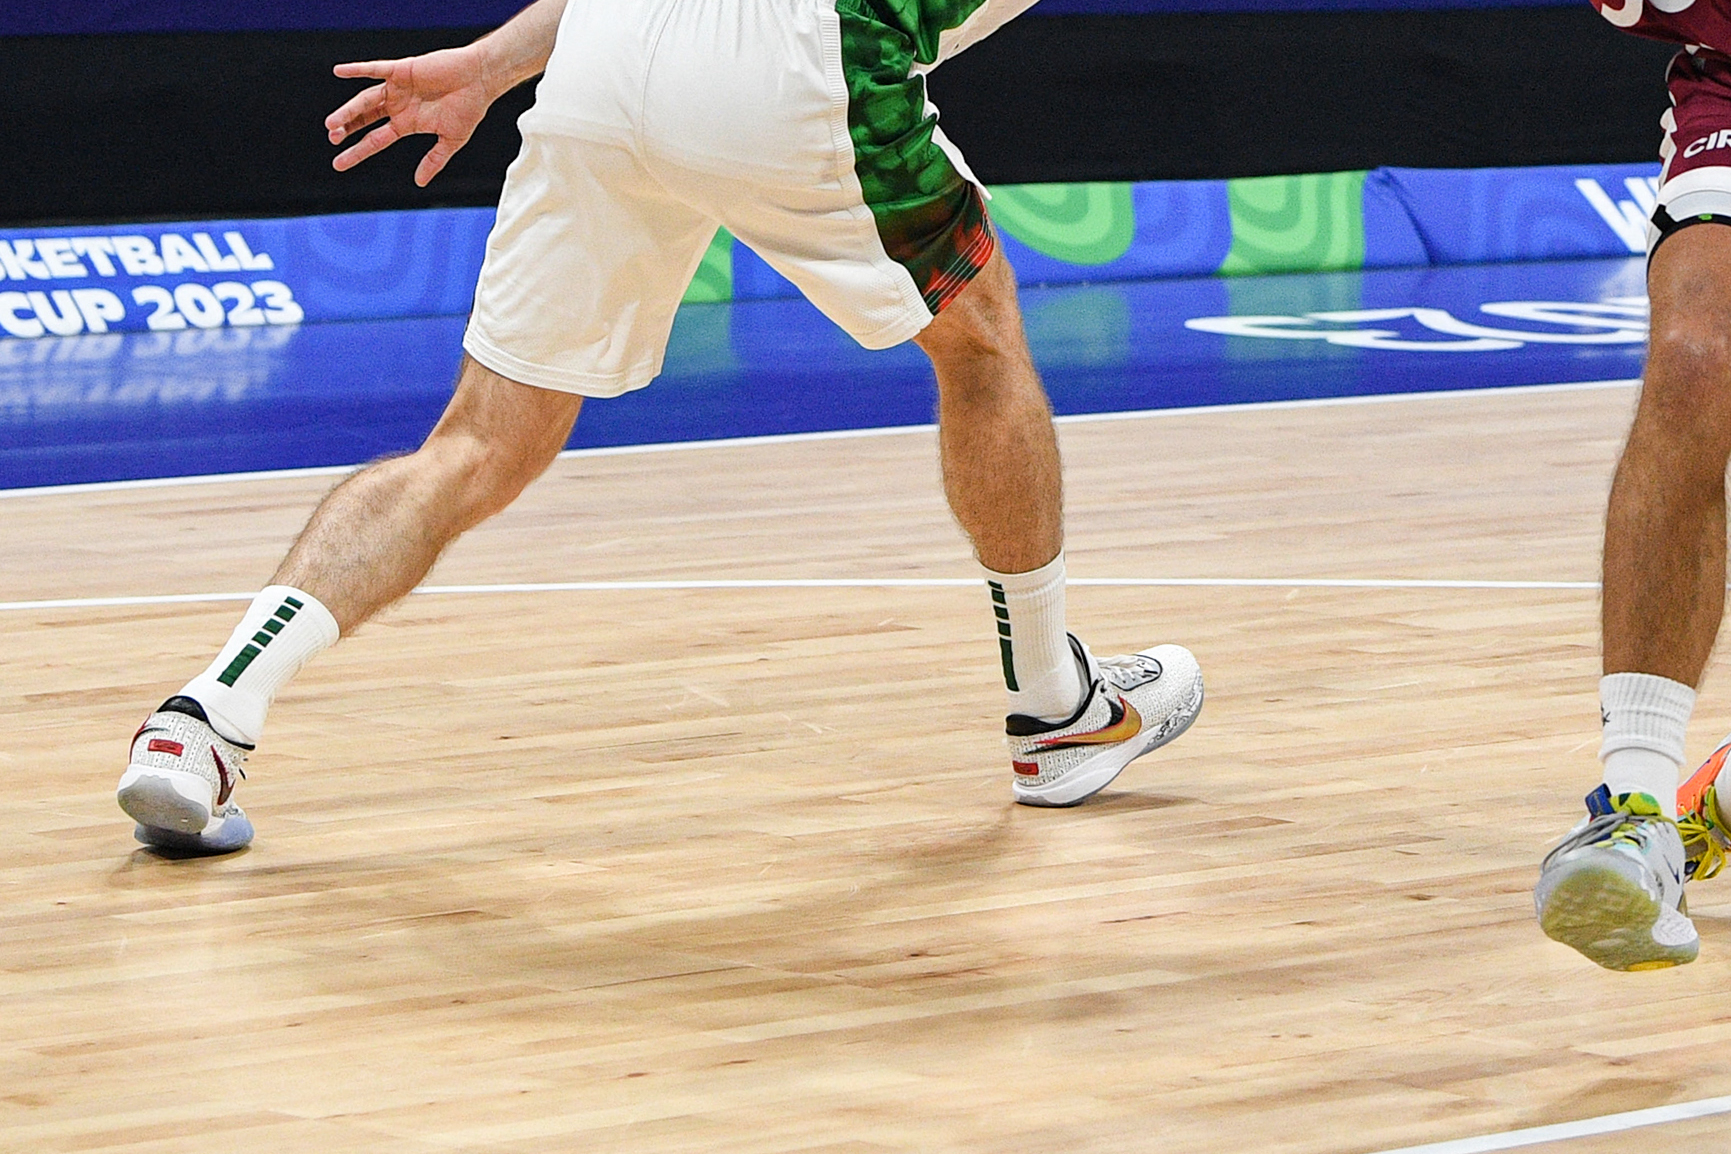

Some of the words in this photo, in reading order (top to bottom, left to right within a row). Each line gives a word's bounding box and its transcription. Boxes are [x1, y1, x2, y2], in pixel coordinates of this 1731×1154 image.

[0, 231, 275, 280] KETBALL
[0, 288, 126, 339] CUP
[131, 279, 304, 331] 2023
